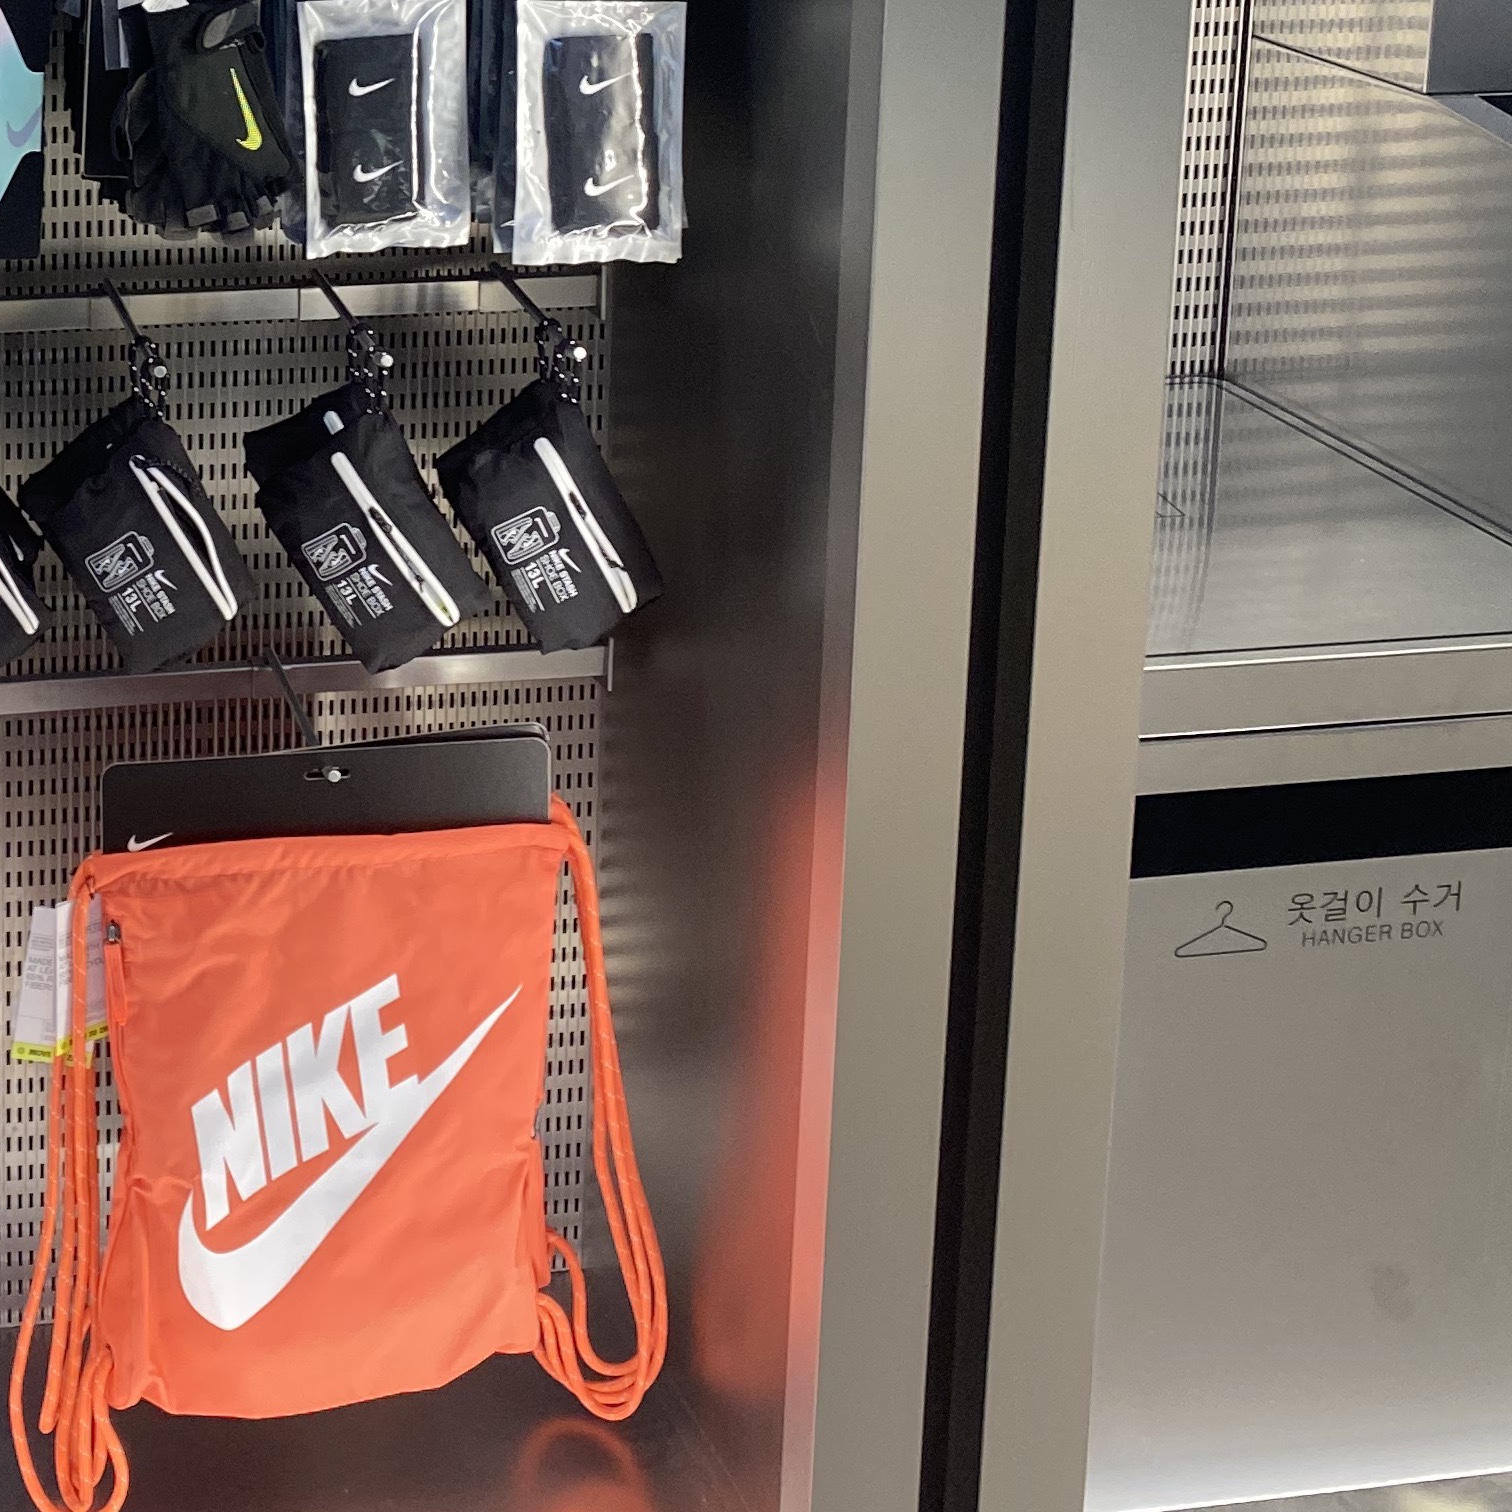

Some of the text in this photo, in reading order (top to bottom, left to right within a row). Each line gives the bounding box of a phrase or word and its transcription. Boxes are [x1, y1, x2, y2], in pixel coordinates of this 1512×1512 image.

[525, 562, 544, 589] 13L
[122, 588, 141, 612] 13L
[337, 580, 357, 605] 13L
[1288, 880, 1463, 926] 옷걸이 수거
[1302, 920, 1443, 947] HANGER BOX
[191, 974, 419, 1230] NIKE
